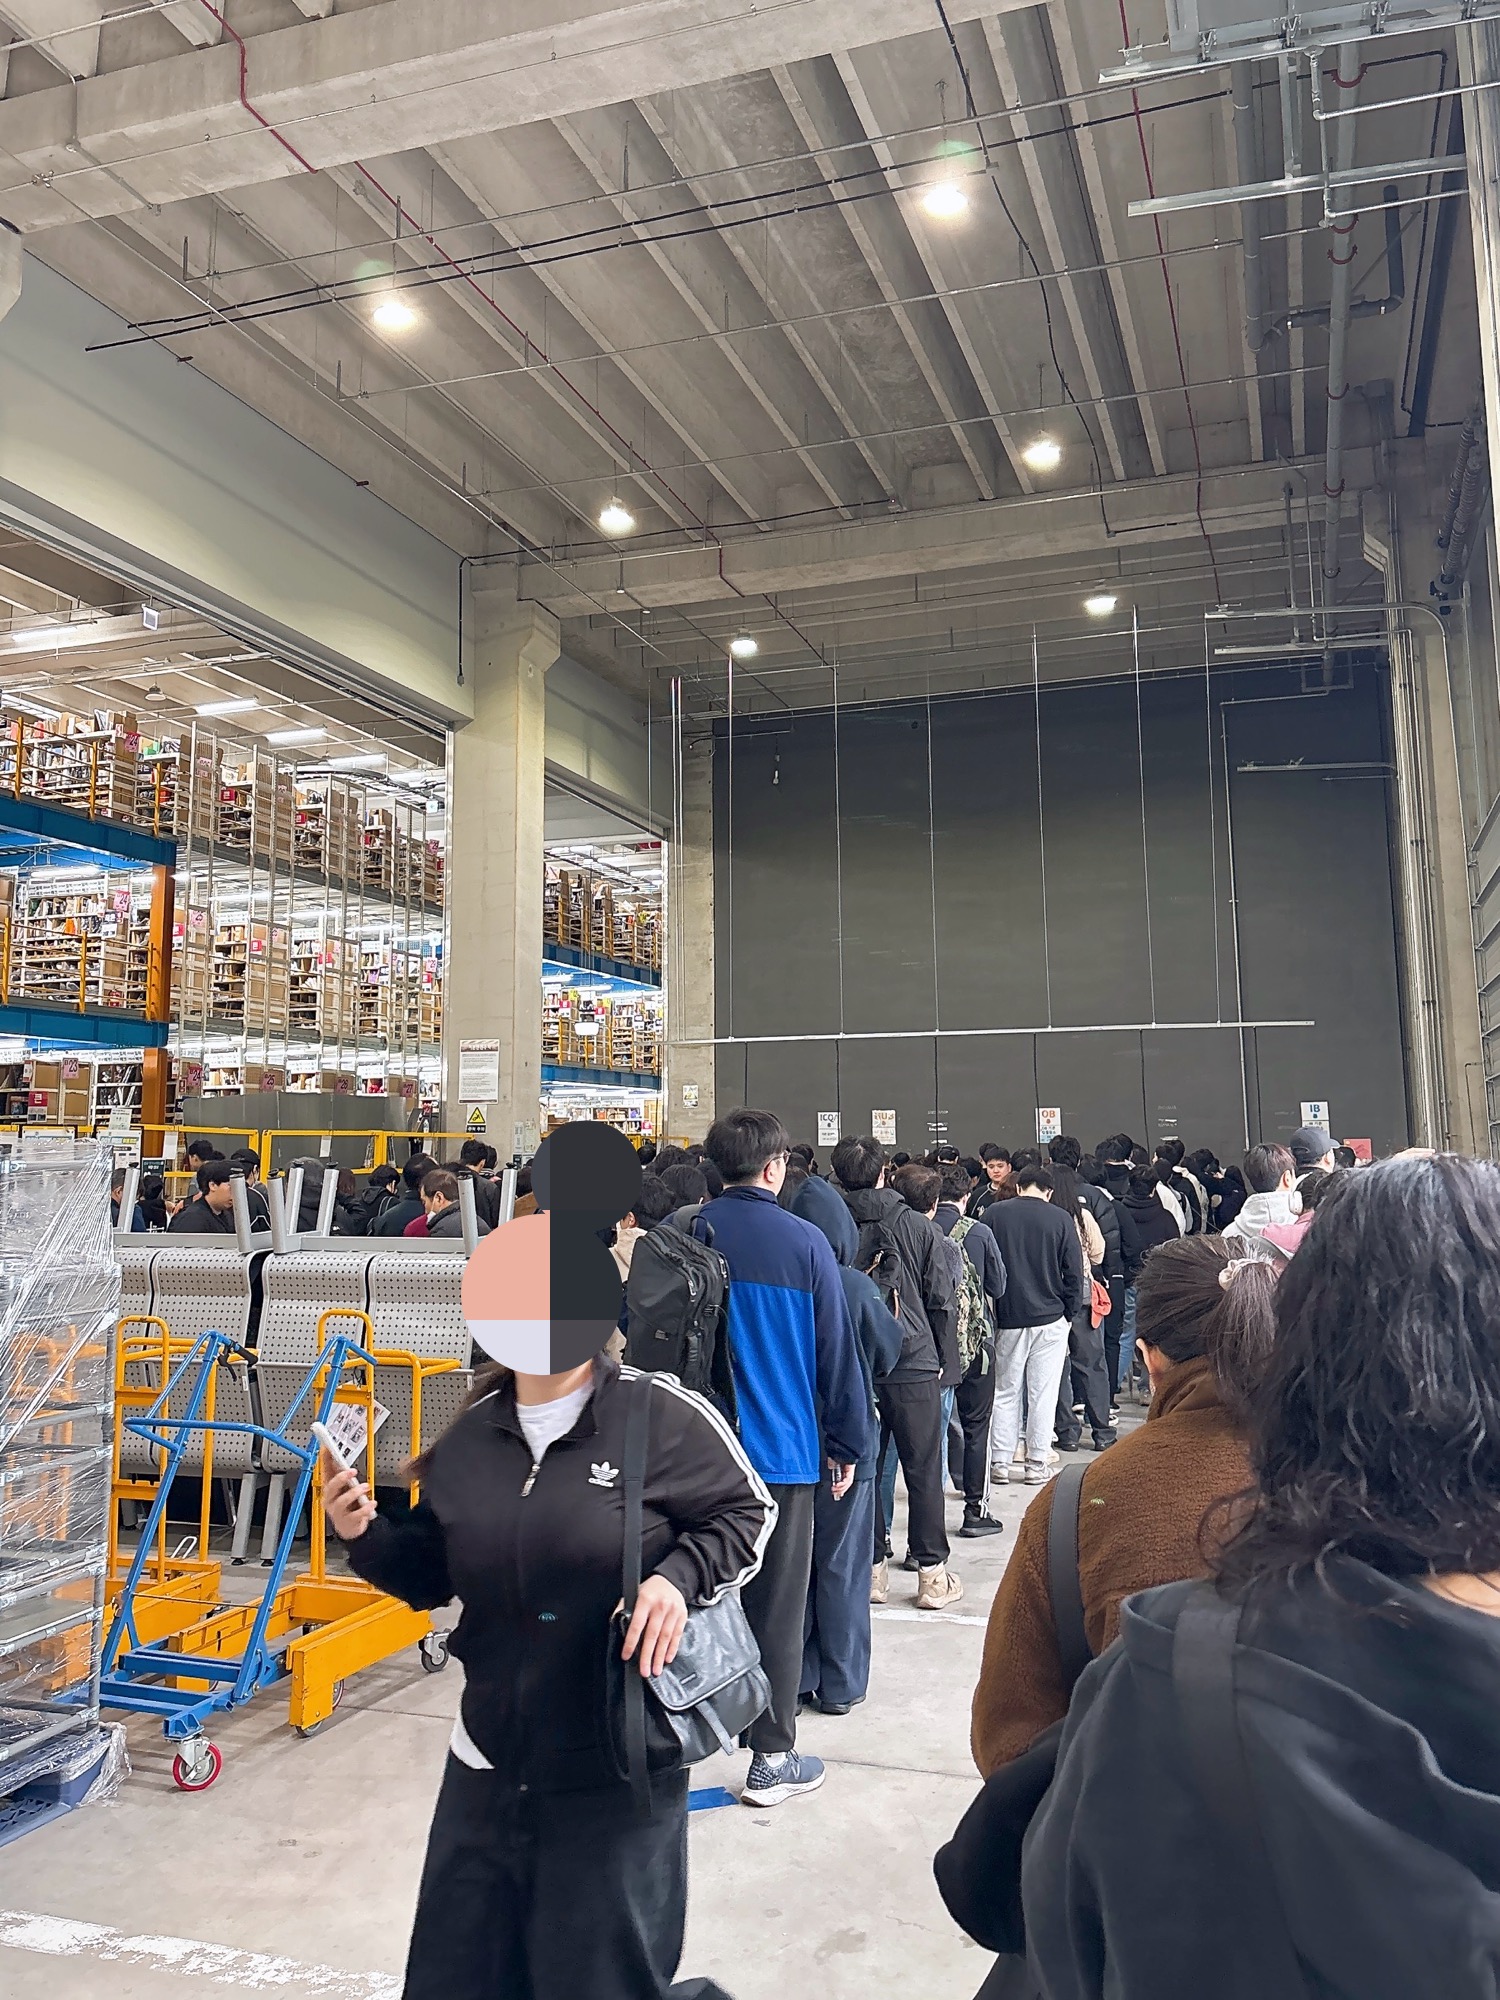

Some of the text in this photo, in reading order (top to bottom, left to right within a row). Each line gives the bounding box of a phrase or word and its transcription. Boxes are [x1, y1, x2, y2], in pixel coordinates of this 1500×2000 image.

[69, 1060, 77, 1072] 23
[1310, 1104, 1320, 1112] IB
[1042, 1110, 1055, 1118] OB
